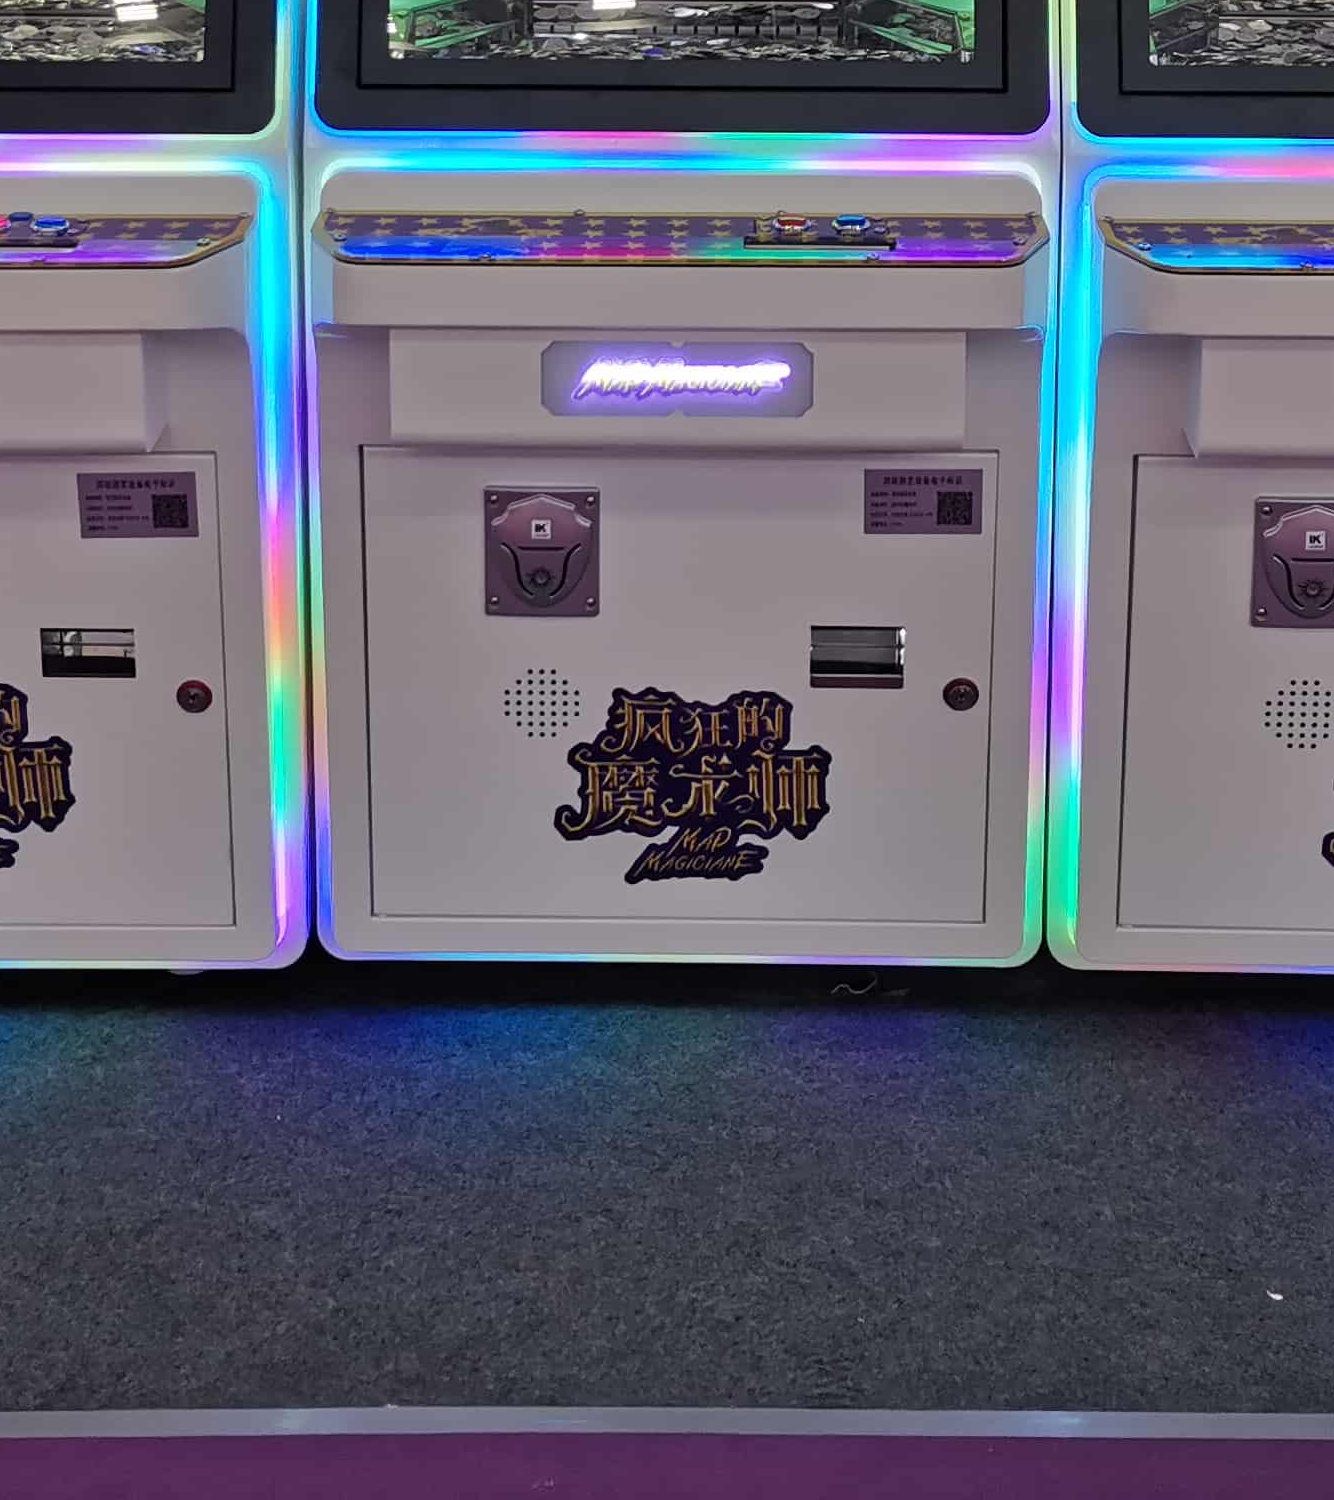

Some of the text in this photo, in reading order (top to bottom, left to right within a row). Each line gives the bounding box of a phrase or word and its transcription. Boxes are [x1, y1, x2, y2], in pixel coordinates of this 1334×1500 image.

[601, 694, 792, 752] 疯狂的
[557, 745, 831, 836] 魔术师
